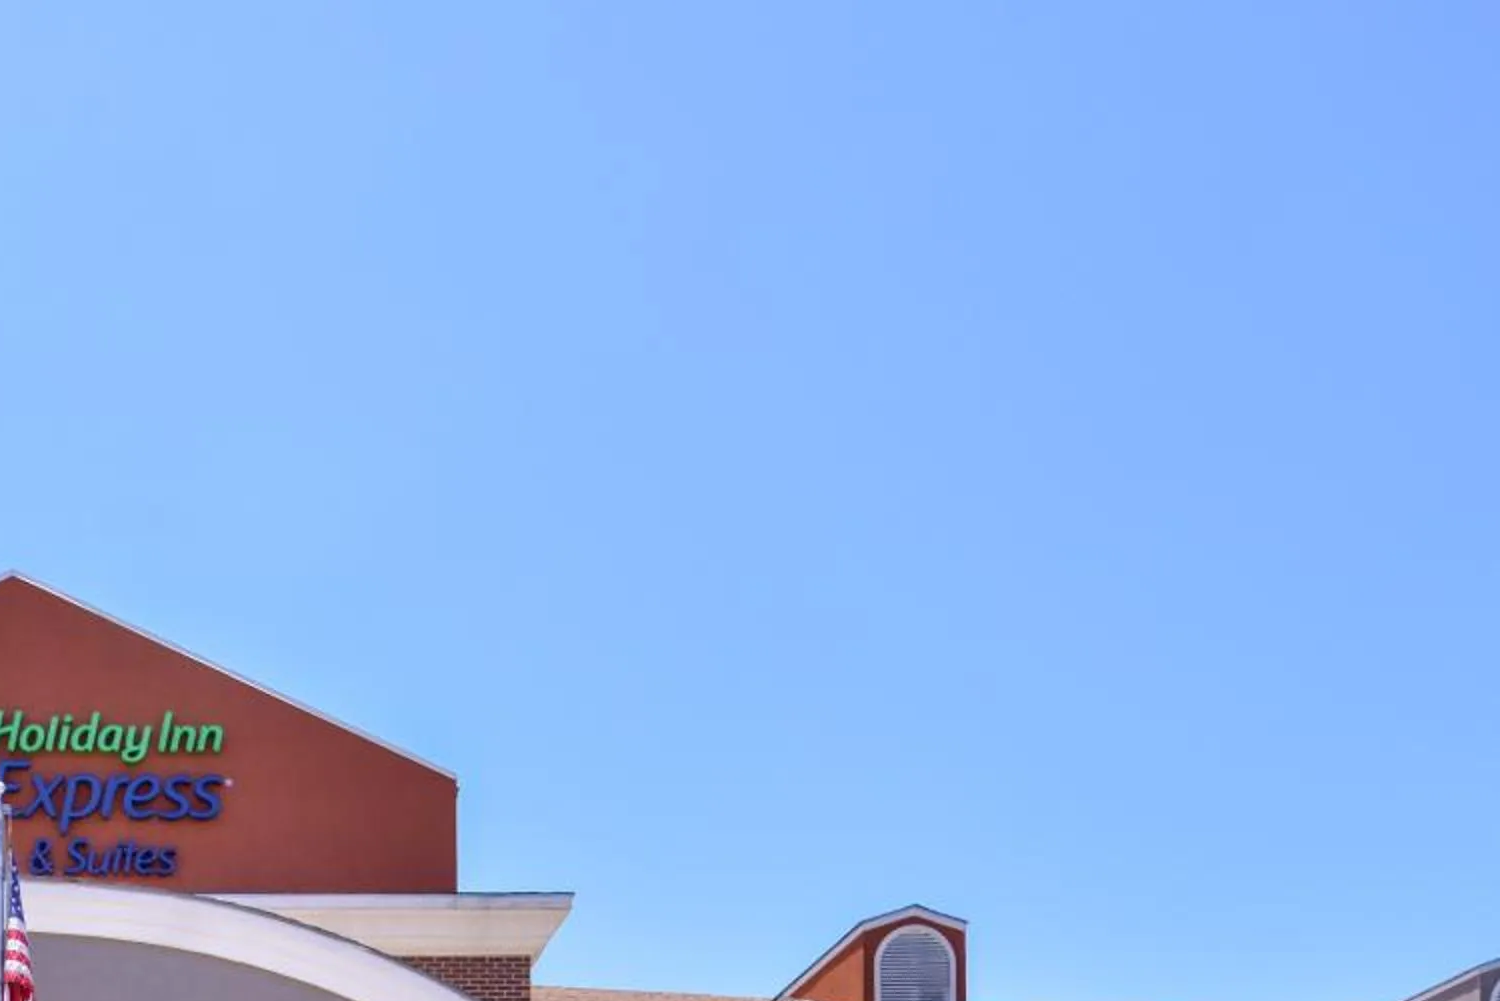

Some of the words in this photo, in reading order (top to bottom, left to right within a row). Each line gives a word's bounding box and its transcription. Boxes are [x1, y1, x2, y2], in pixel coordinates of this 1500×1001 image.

[158, 709, 224, 753] Inn
[29, 837, 54, 876] &
[63, 837, 178, 877] Suites
